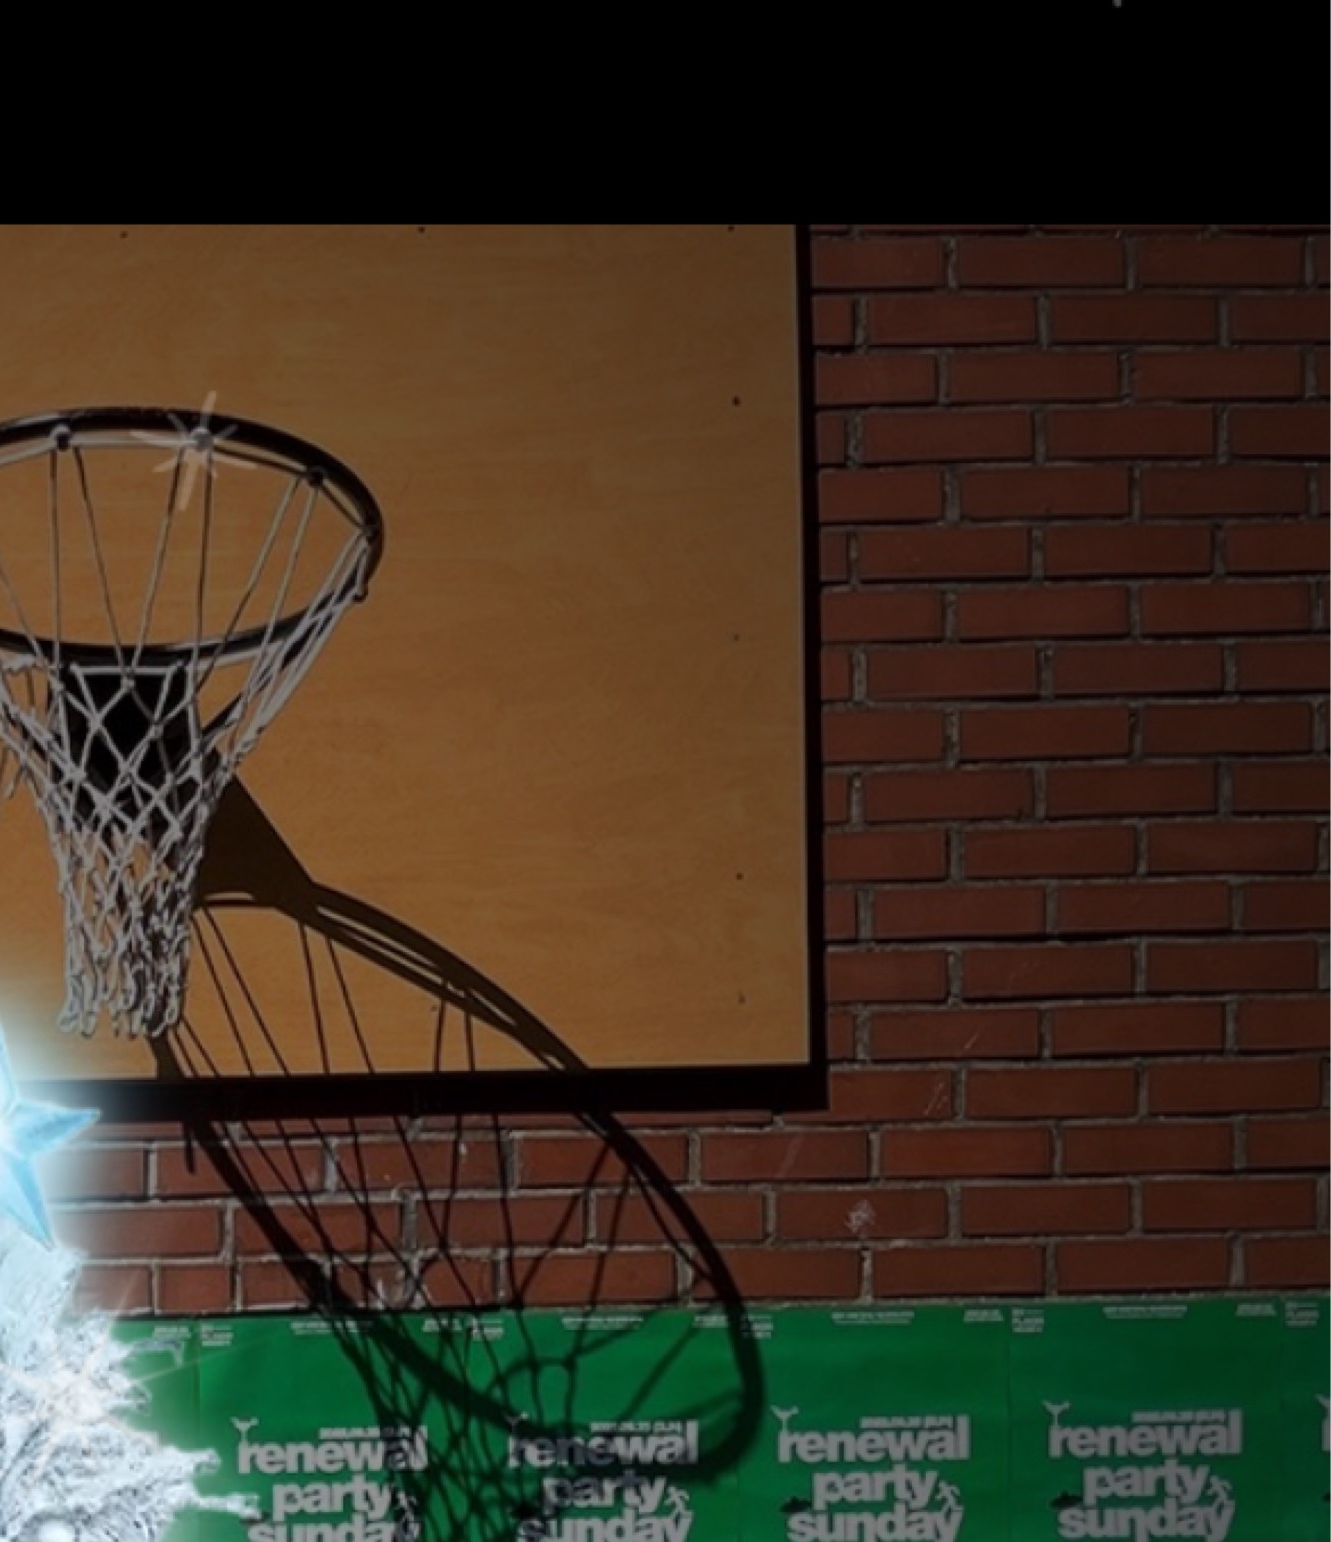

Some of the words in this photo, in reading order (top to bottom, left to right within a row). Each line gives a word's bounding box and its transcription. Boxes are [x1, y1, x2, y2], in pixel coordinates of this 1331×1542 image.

[239, 1428, 426, 1472] renewal
[779, 1416, 969, 1461] renewal
[1050, 1411, 1241, 1456] renewal
[272, 1475, 396, 1520] party
[542, 1469, 667, 1514] party
[813, 1464, 938, 1509] party
[1084, 1459, 1210, 1504] party
